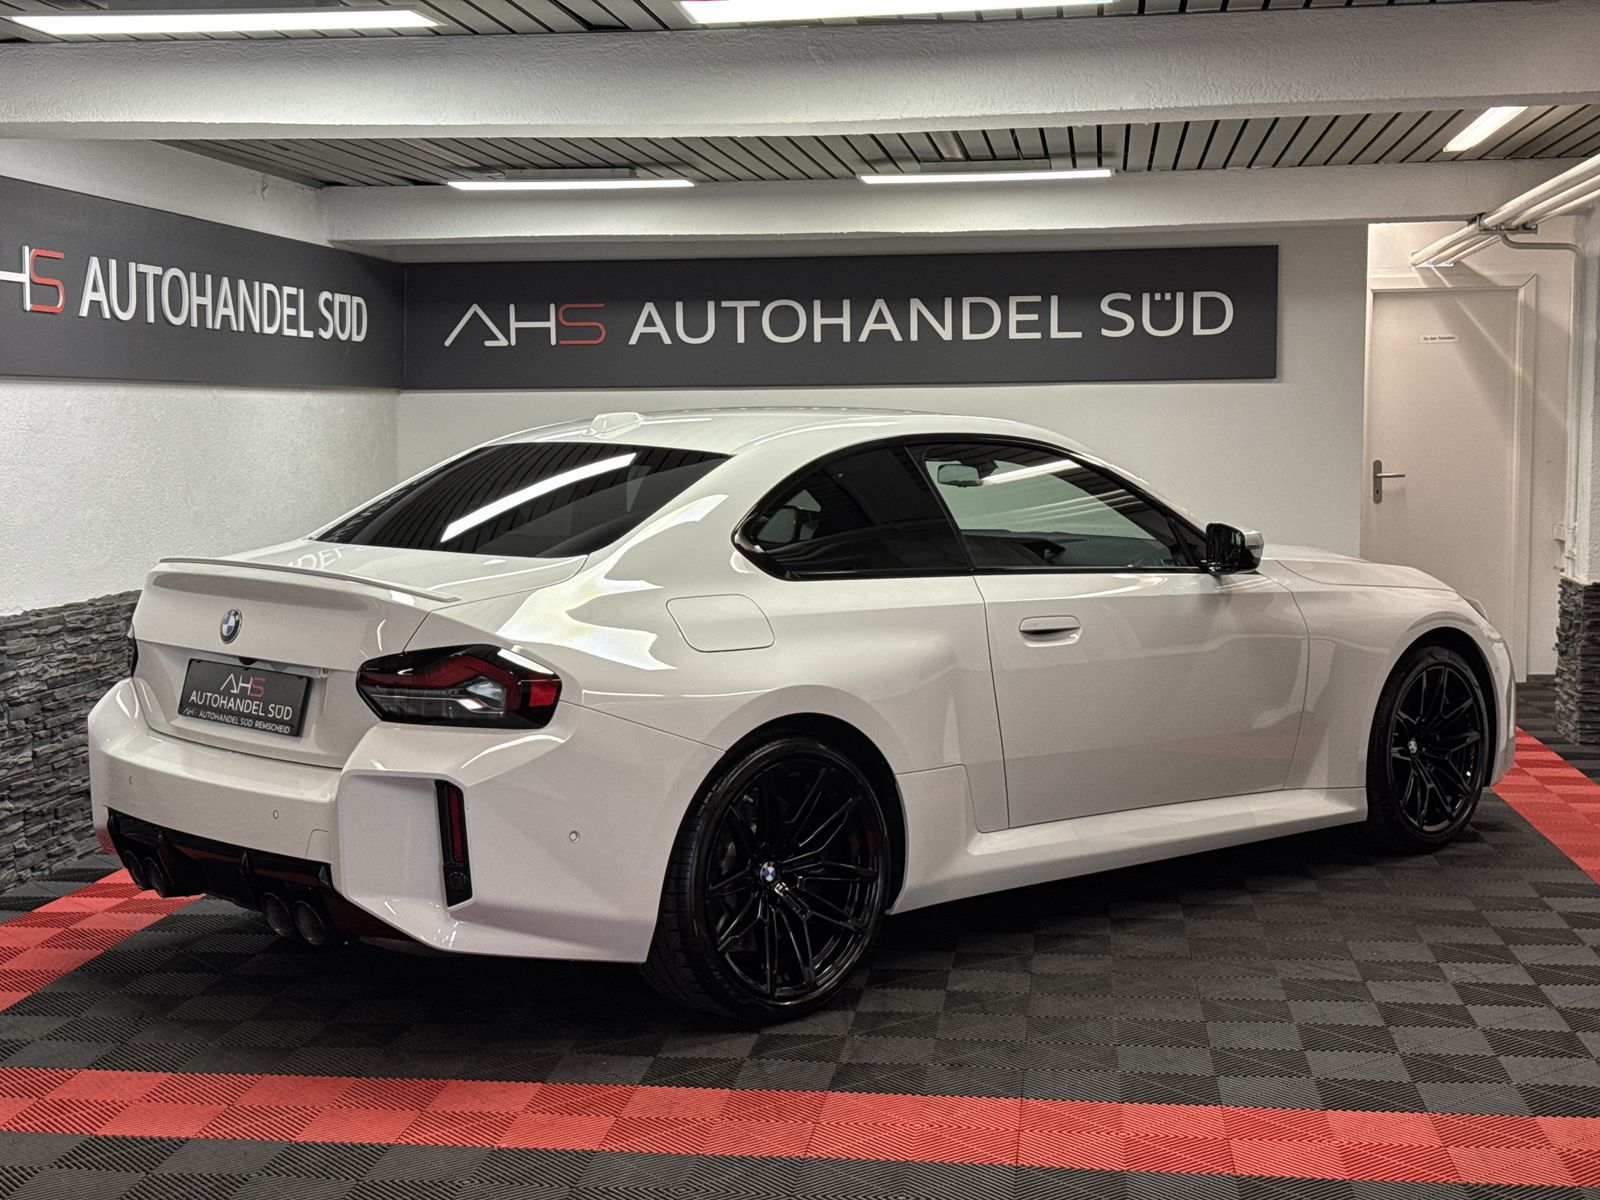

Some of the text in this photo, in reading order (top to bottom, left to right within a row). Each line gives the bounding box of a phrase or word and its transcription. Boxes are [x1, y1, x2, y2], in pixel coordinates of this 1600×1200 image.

[79, 256, 314, 339] AUTOHANDEL
[318, 290, 367, 342] SÜD
[444, 290, 1234, 347] AHS AUTOHANDEL SÜD
[220, 673, 267, 698] AHS
[189, 690, 293, 720] AUTOHANDEL SÜD
[199, 710, 239, 725] AUTOHANDEL
[254, 720, 290, 734] REMSCHEID
